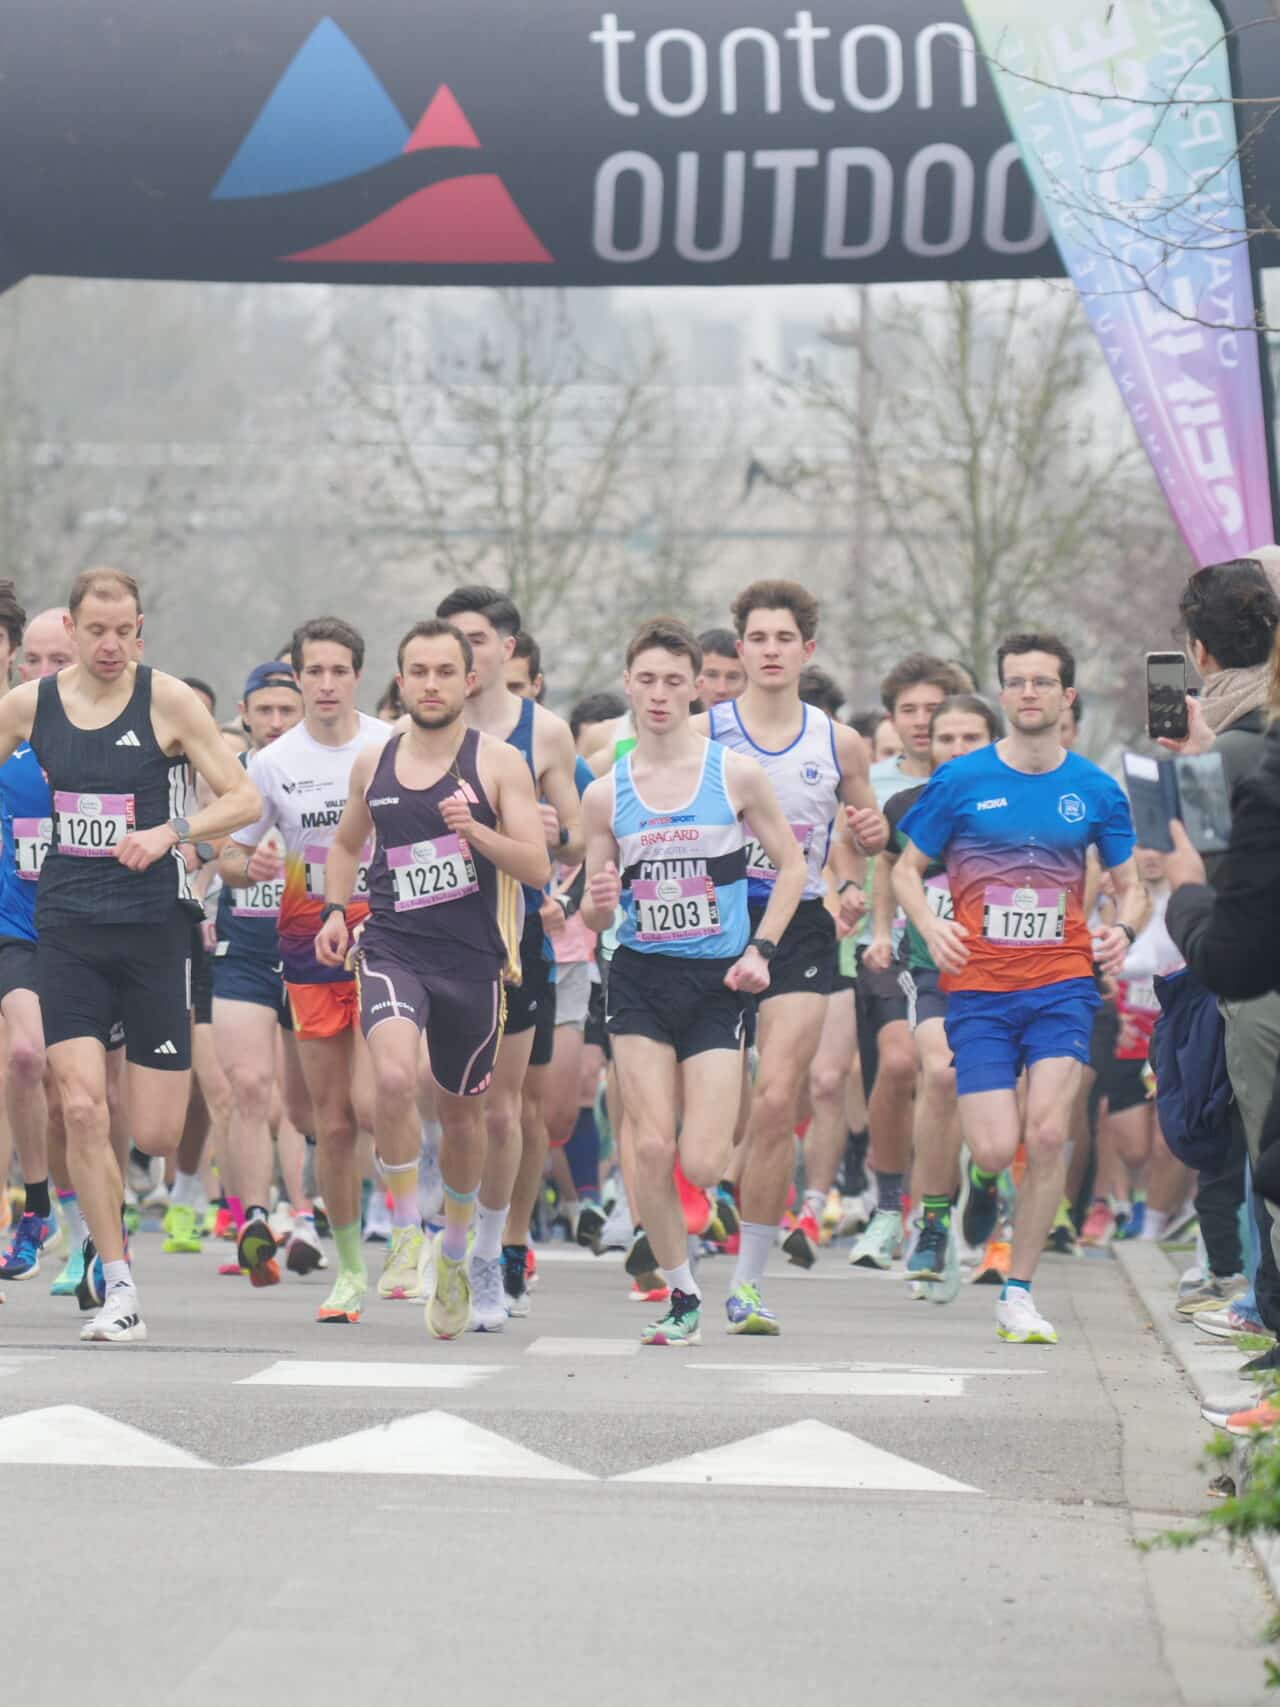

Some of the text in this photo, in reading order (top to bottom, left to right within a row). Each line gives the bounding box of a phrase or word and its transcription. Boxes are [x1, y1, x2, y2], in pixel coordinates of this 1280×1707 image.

[590, 10, 977, 118] tonton
[593, 142, 1053, 263] OUTDOO
[67, 818, 117, 847] 1202
[640, 829, 700, 847] BRAGARD
[406, 861, 458, 897] 1223
[640, 859, 707, 880] COHM
[648, 901, 701, 931] 1203
[1001, 911, 1047, 938] 1737
